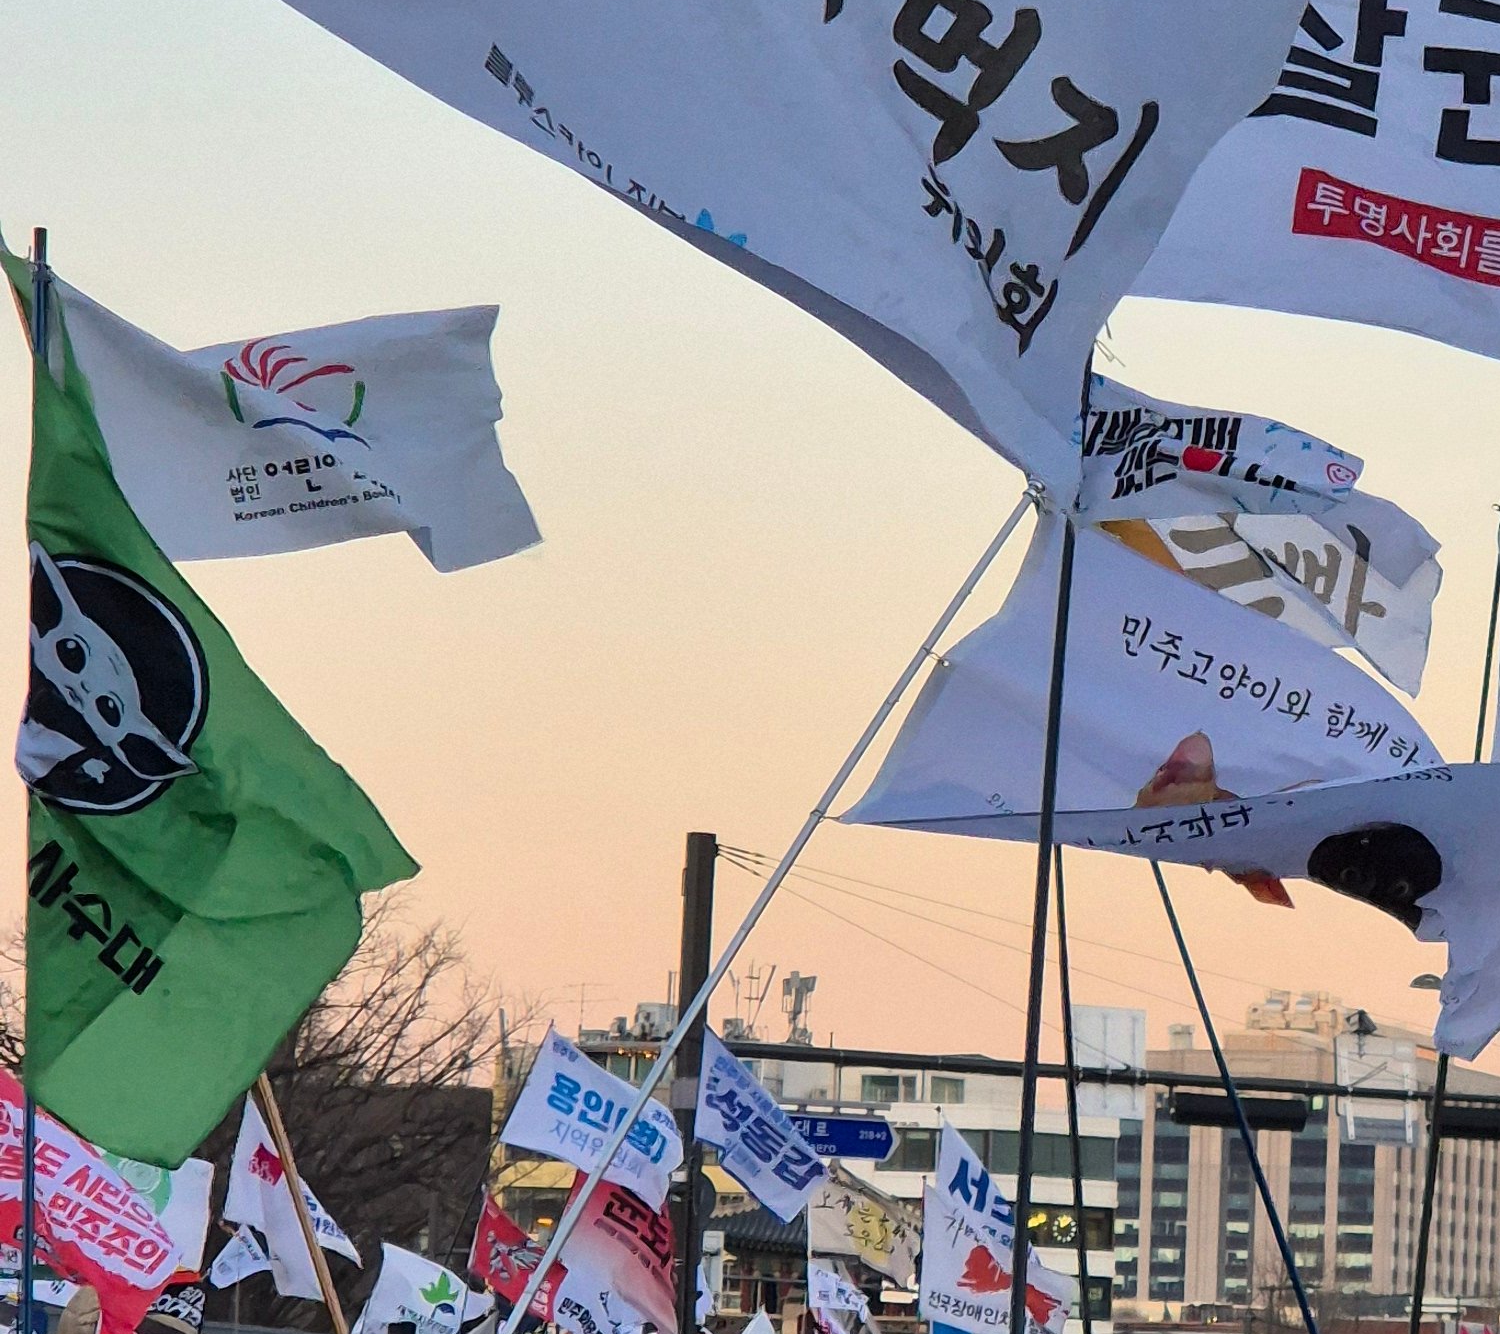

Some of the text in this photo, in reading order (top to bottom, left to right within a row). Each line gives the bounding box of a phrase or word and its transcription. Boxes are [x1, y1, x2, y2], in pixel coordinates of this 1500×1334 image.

[233, 507, 286, 522] Korean
[289, 494, 360, 514] Children's
[1121, 612, 1312, 723] 민주고양이와
[1325, 703, 1390, 754] 함께
[794, 1119, 830, 1138] 대로
